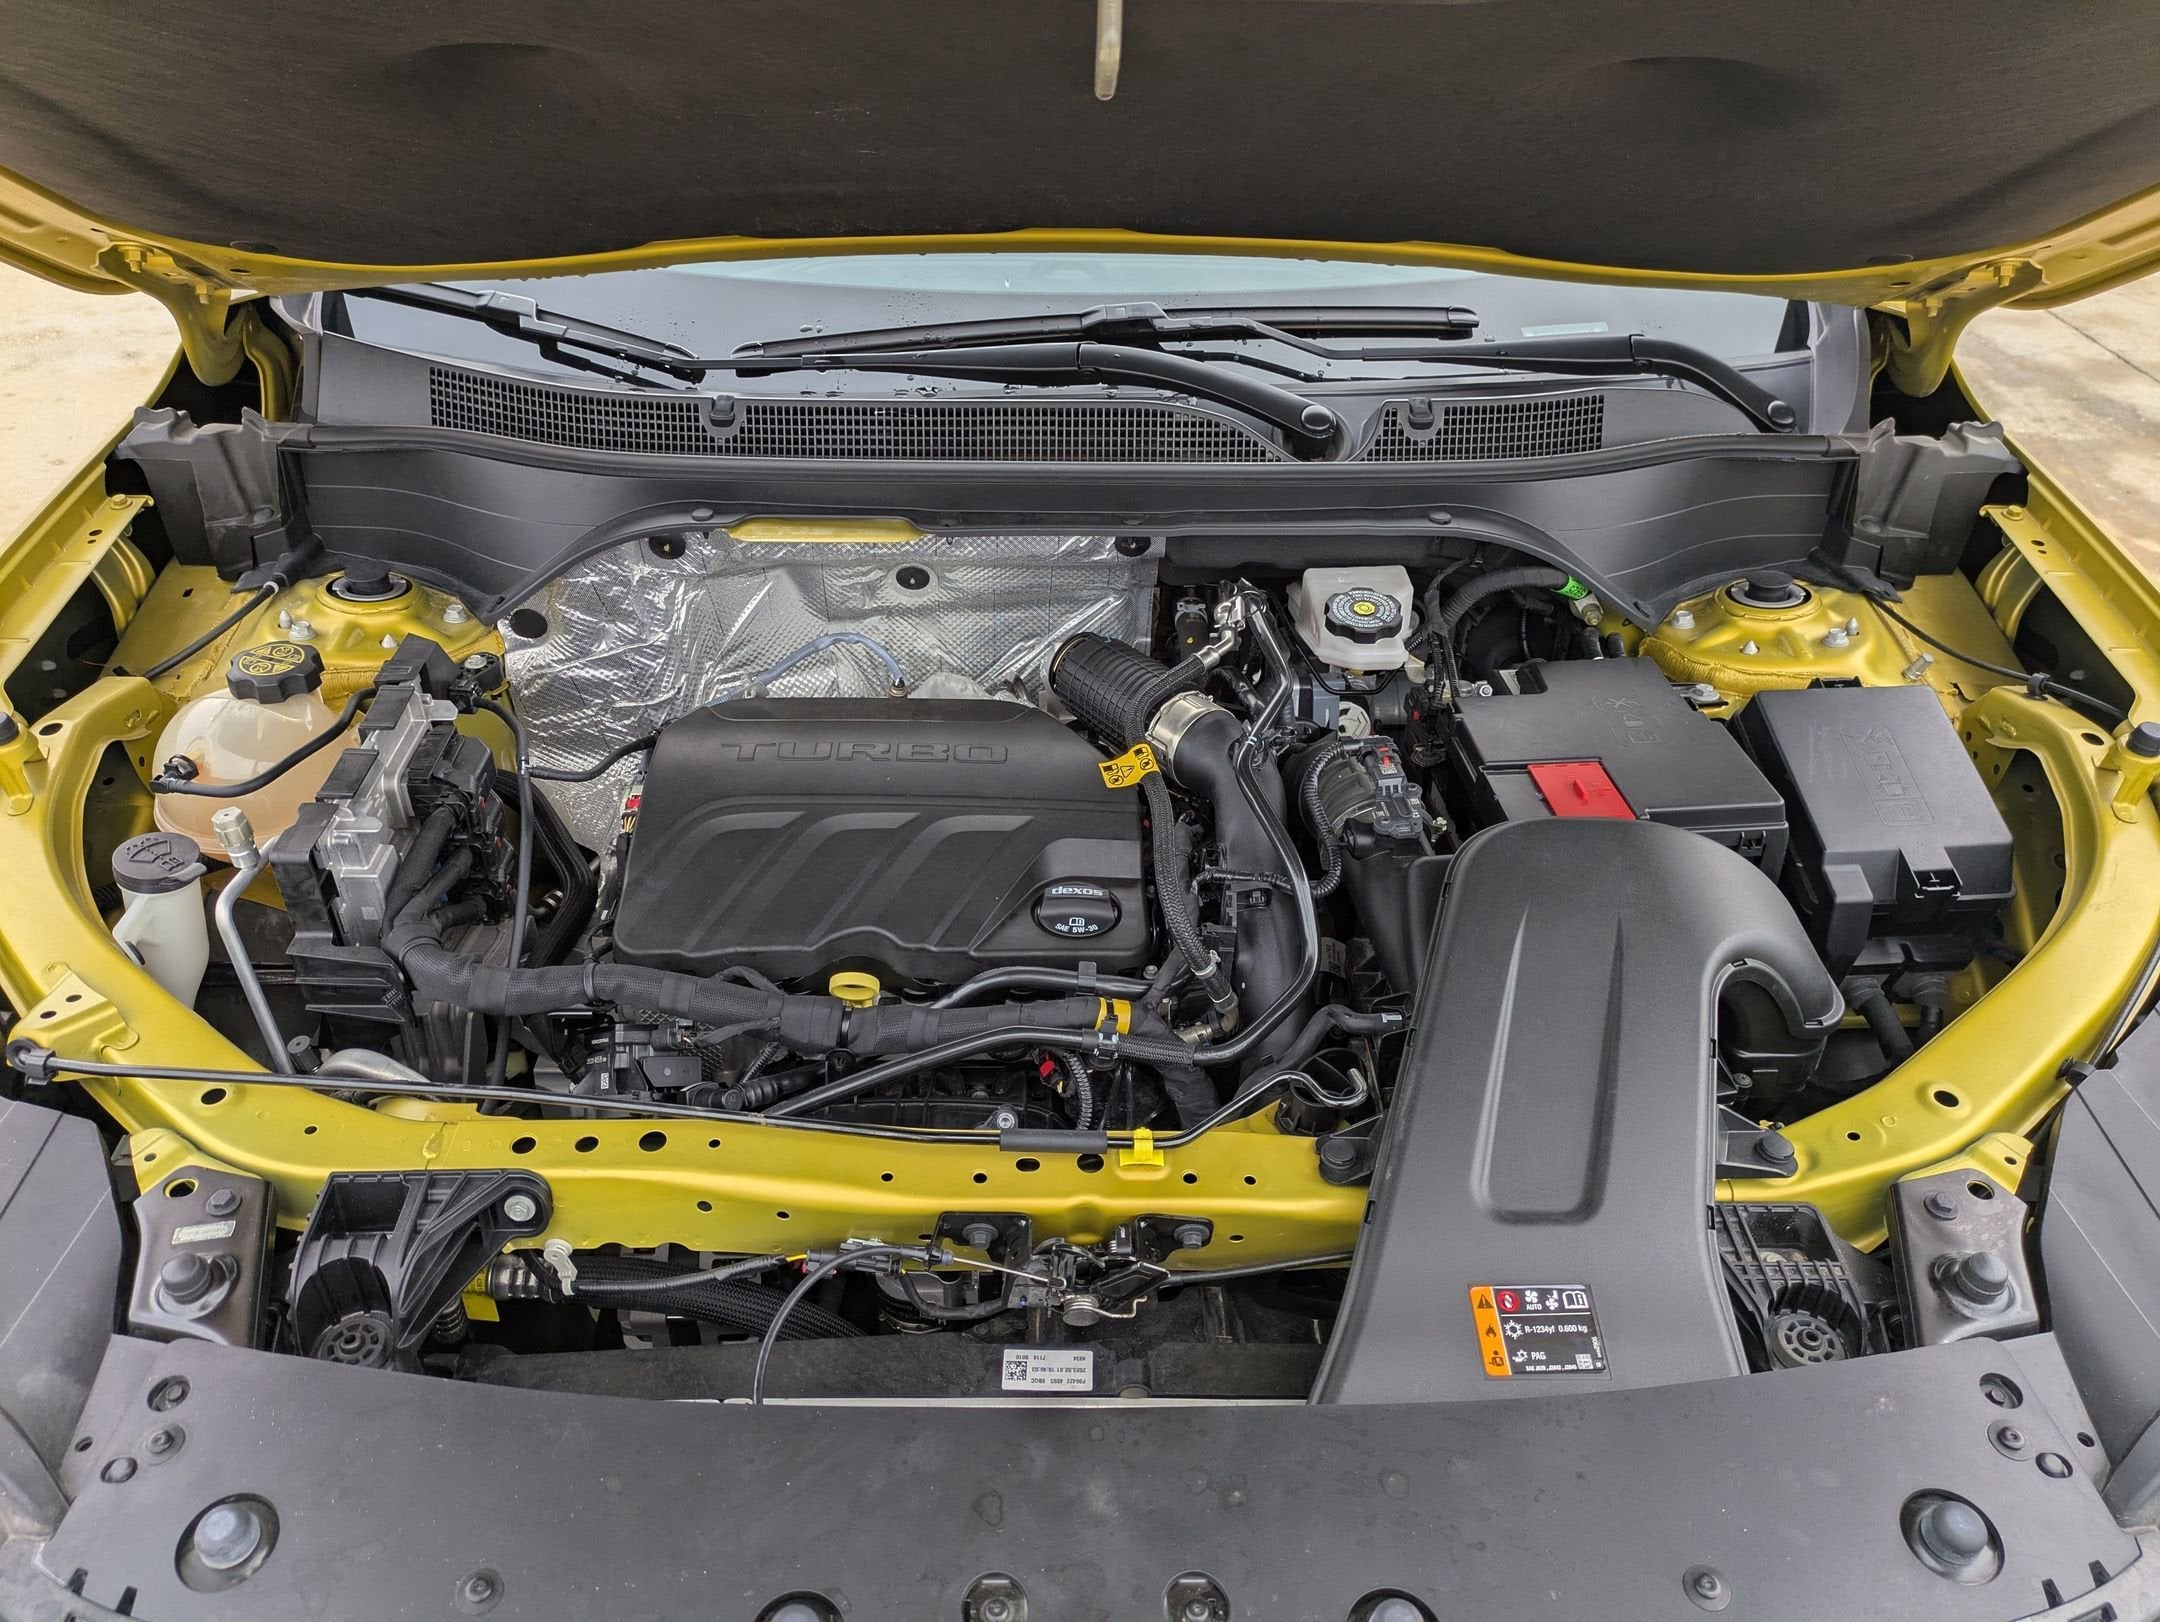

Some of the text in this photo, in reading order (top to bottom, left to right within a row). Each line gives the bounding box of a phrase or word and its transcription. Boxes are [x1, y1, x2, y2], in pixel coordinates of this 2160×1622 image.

[721, 741, 1009, 764] TURBO
[1051, 886, 1103, 896] dexos
[1055, 923, 1098, 933] SAE 5W-30
[1525, 1324, 1588, 1334] R-1234yf 0.600 kg
[1531, 1352, 1546, 1360] PAG
